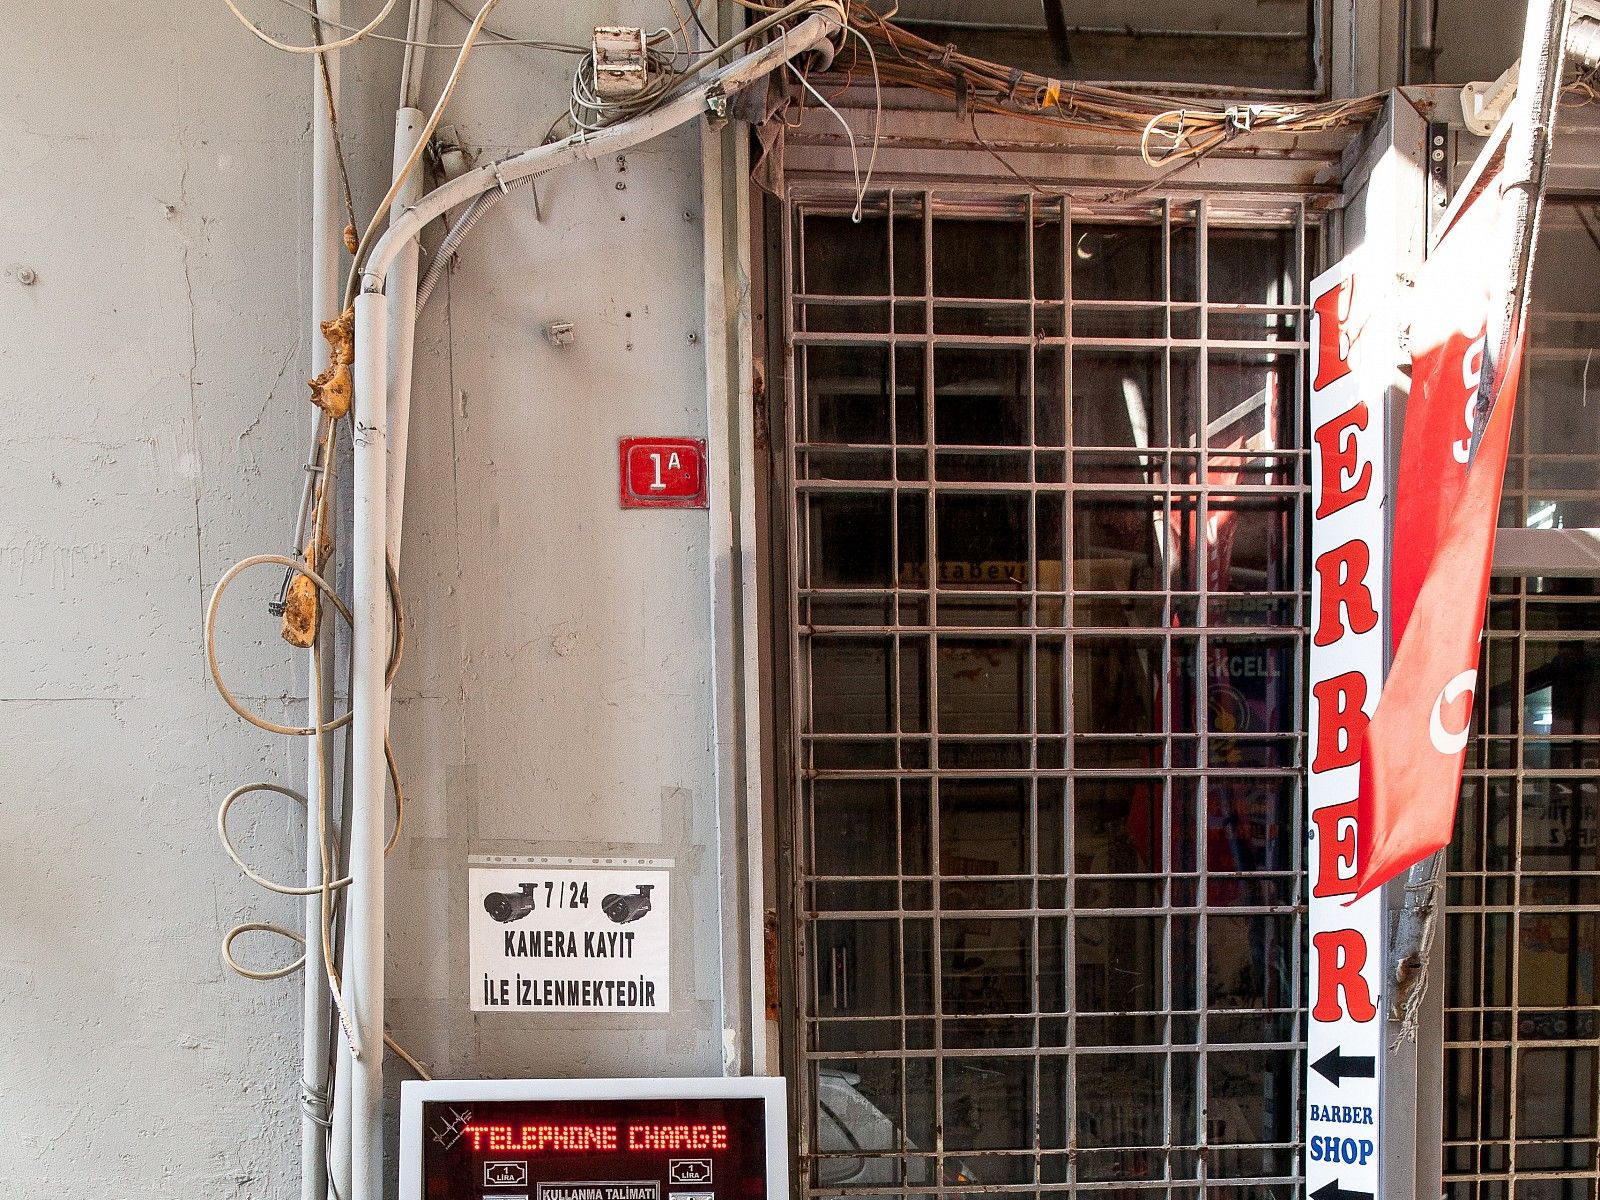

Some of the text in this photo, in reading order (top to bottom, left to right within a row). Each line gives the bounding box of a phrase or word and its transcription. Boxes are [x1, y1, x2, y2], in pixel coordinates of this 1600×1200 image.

[504, 930, 635, 958] KAMERA KAYIT
[483, 972, 656, 1007] İLE İZLENMEKTEDİR
[1310, 1104, 1374, 1125] BARBER
[465, 1125, 617, 1150] TELEPHONE
[629, 1125, 727, 1149] CHARGE
[1310, 1135, 1374, 1166] SHOP
[496, 1173, 515, 1181] LİRA
[503, 1166, 509, 1174] 1
[681, 1170, 700, 1179] LİRA
[687, 1164, 694, 1172] 1
[542, 1185, 656, 1200] KULLANMA TALİMATI
